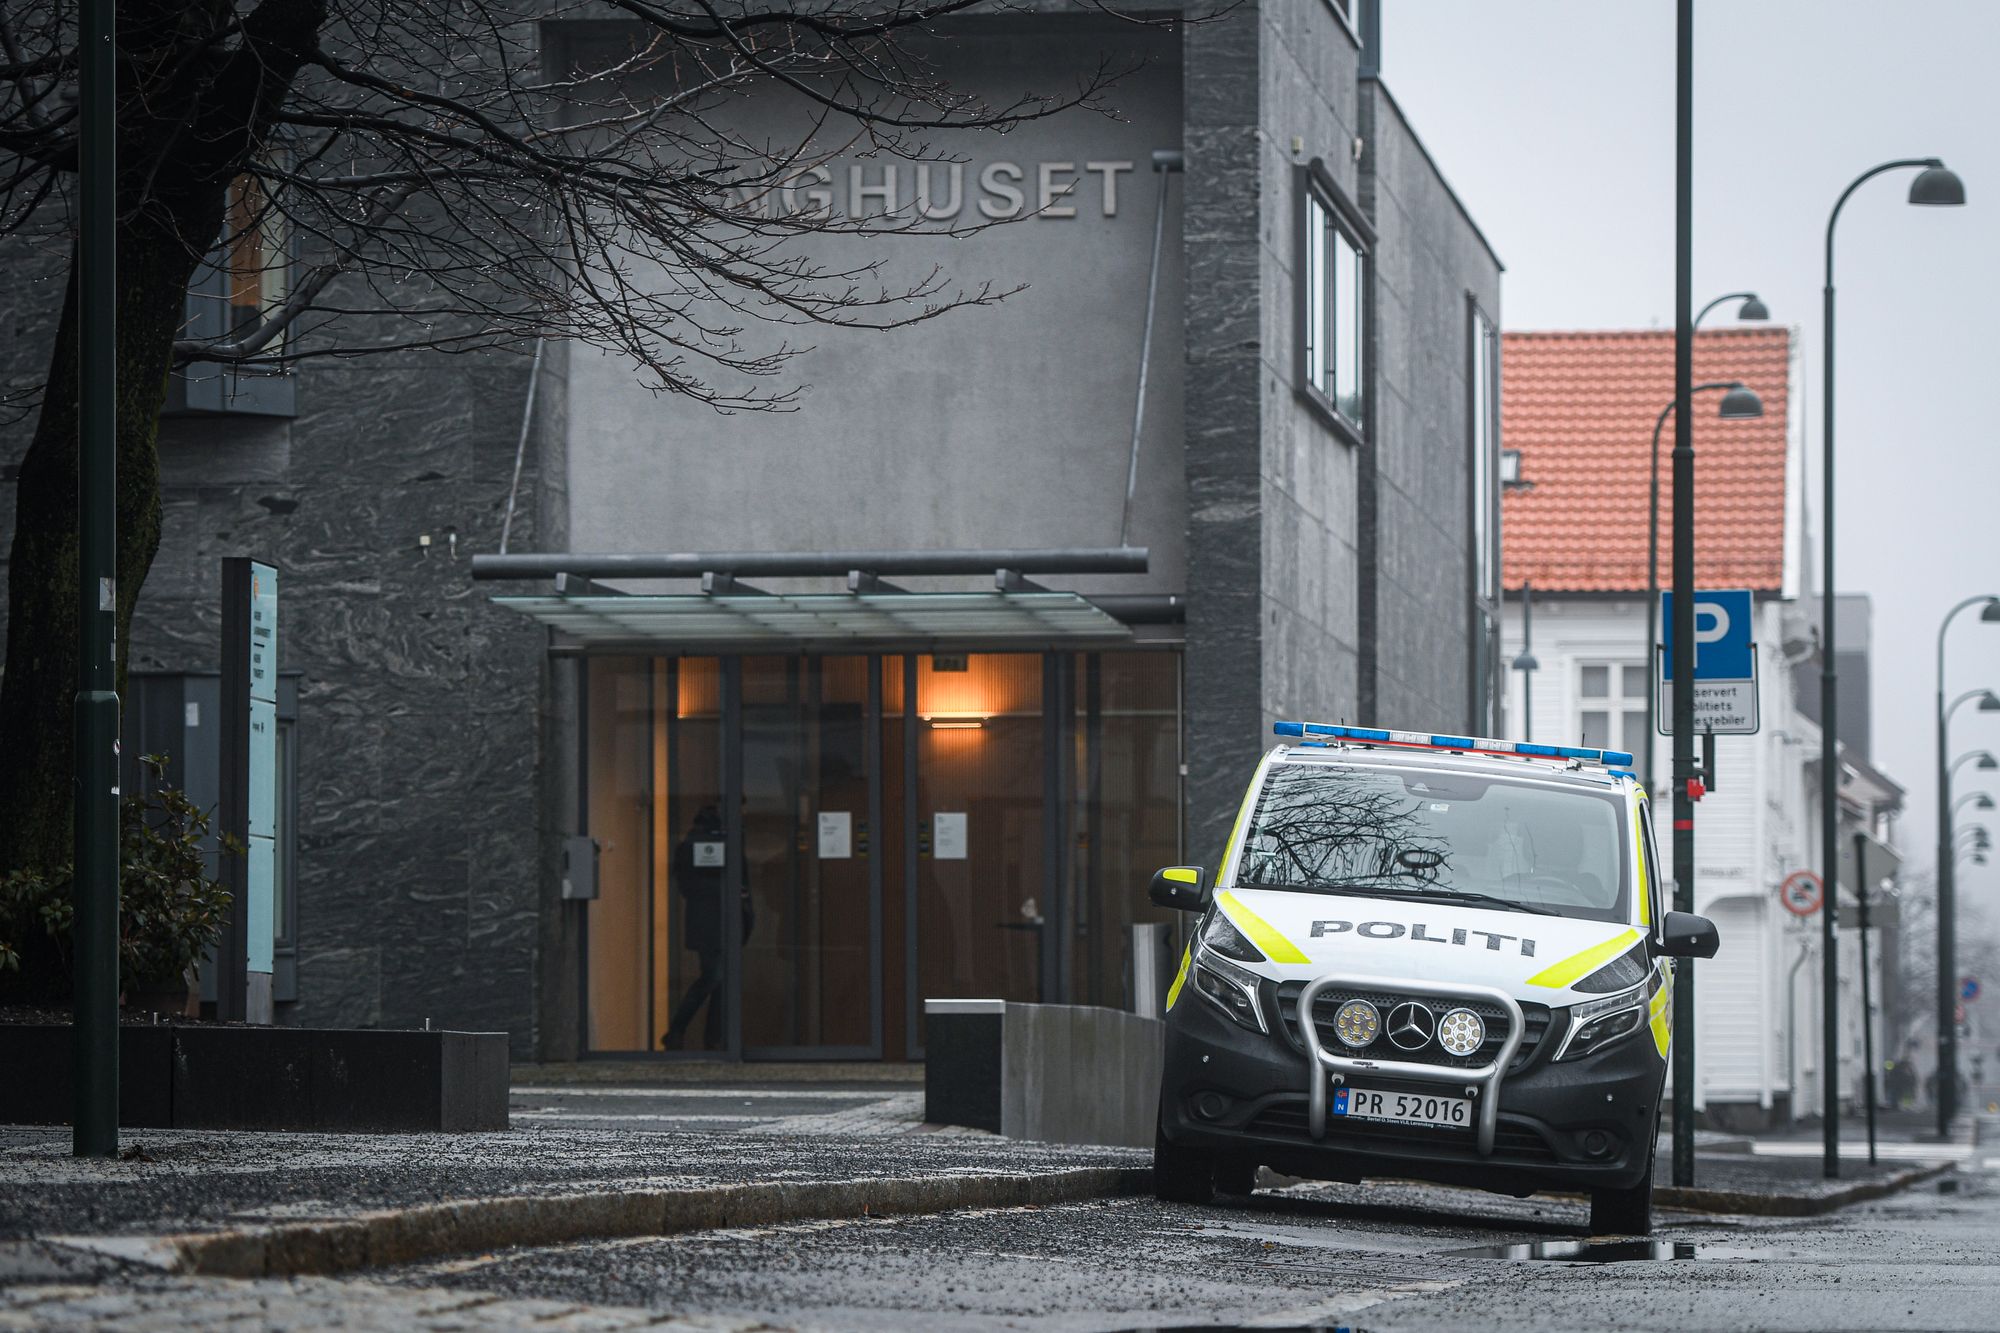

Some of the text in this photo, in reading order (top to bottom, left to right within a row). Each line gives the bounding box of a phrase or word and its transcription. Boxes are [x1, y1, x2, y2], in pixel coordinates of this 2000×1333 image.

[722, 161, 1133, 221] NGHUSET
[1693, 602, 1730, 669] P
[1693, 702, 1732, 712] olitiets
[1694, 687, 1737, 697] servert
[1310, 920, 1536, 958] POLITI
[1337, 1103, 1345, 1111] N
[1354, 1092, 1464, 1122] PR 52016
